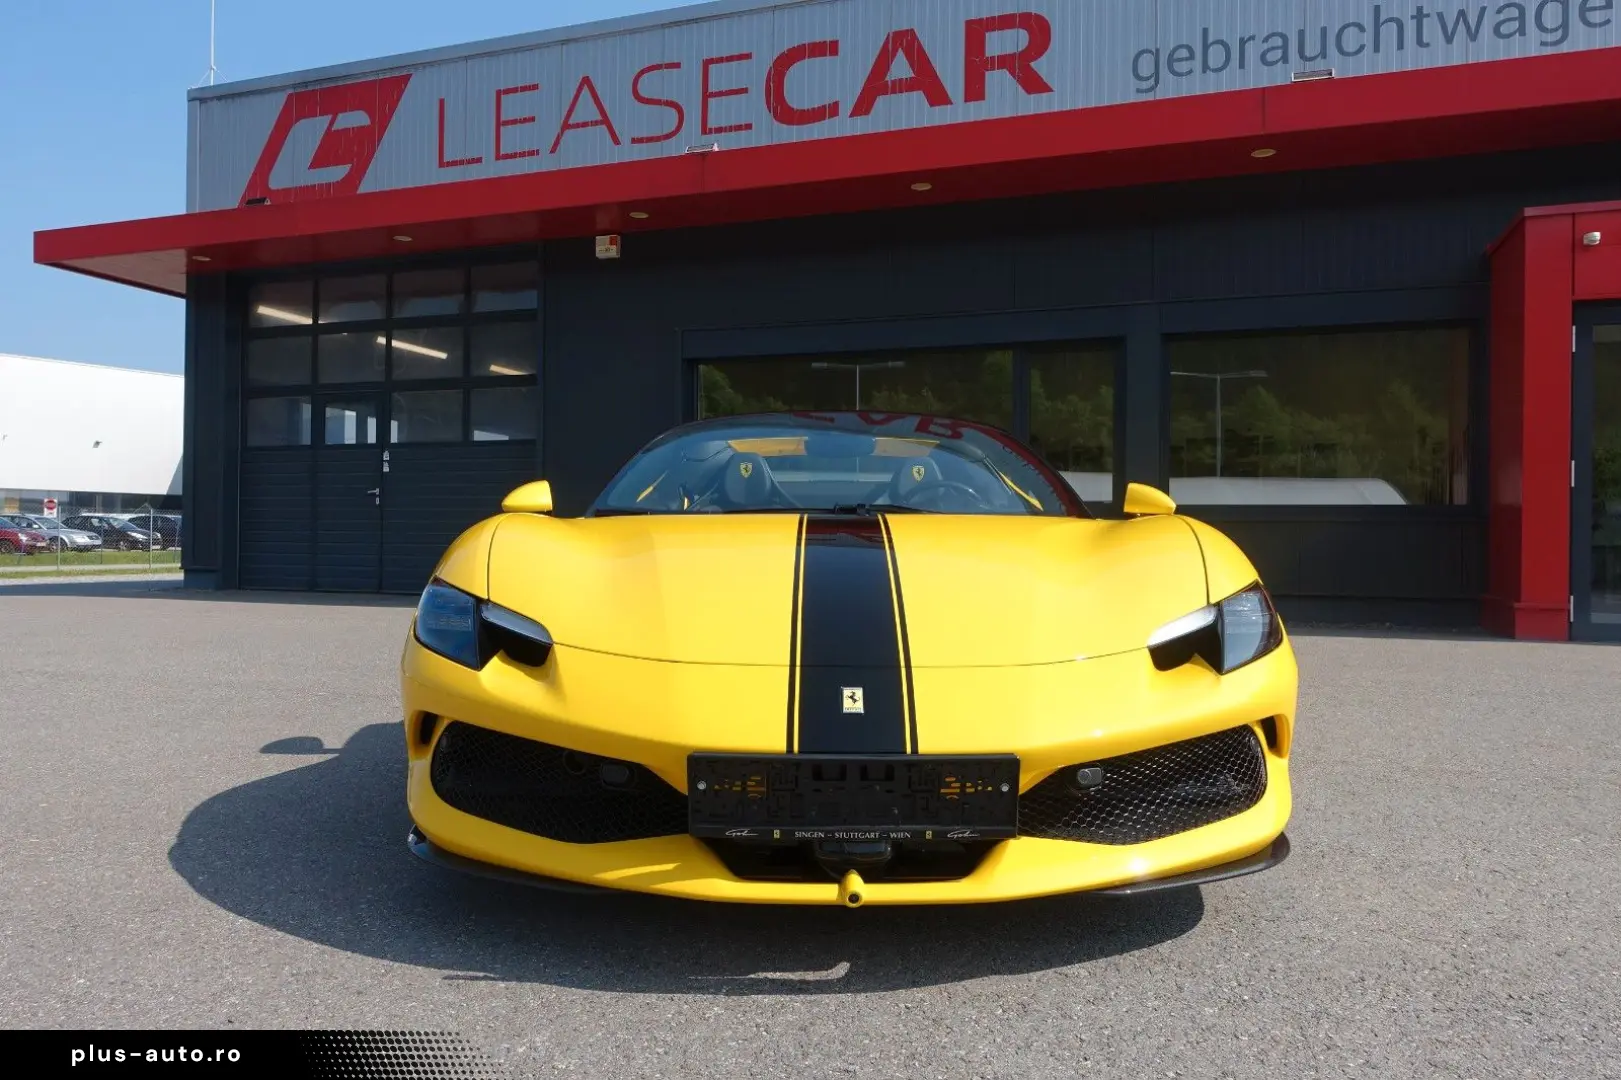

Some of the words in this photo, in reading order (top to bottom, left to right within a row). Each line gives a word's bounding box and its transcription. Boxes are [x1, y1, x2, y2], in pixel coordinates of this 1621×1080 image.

[438, 12, 1055, 169] LEASECAR
[834, 831, 880, 839] STUTTGART
[889, 831, 912, 839] WIEN
